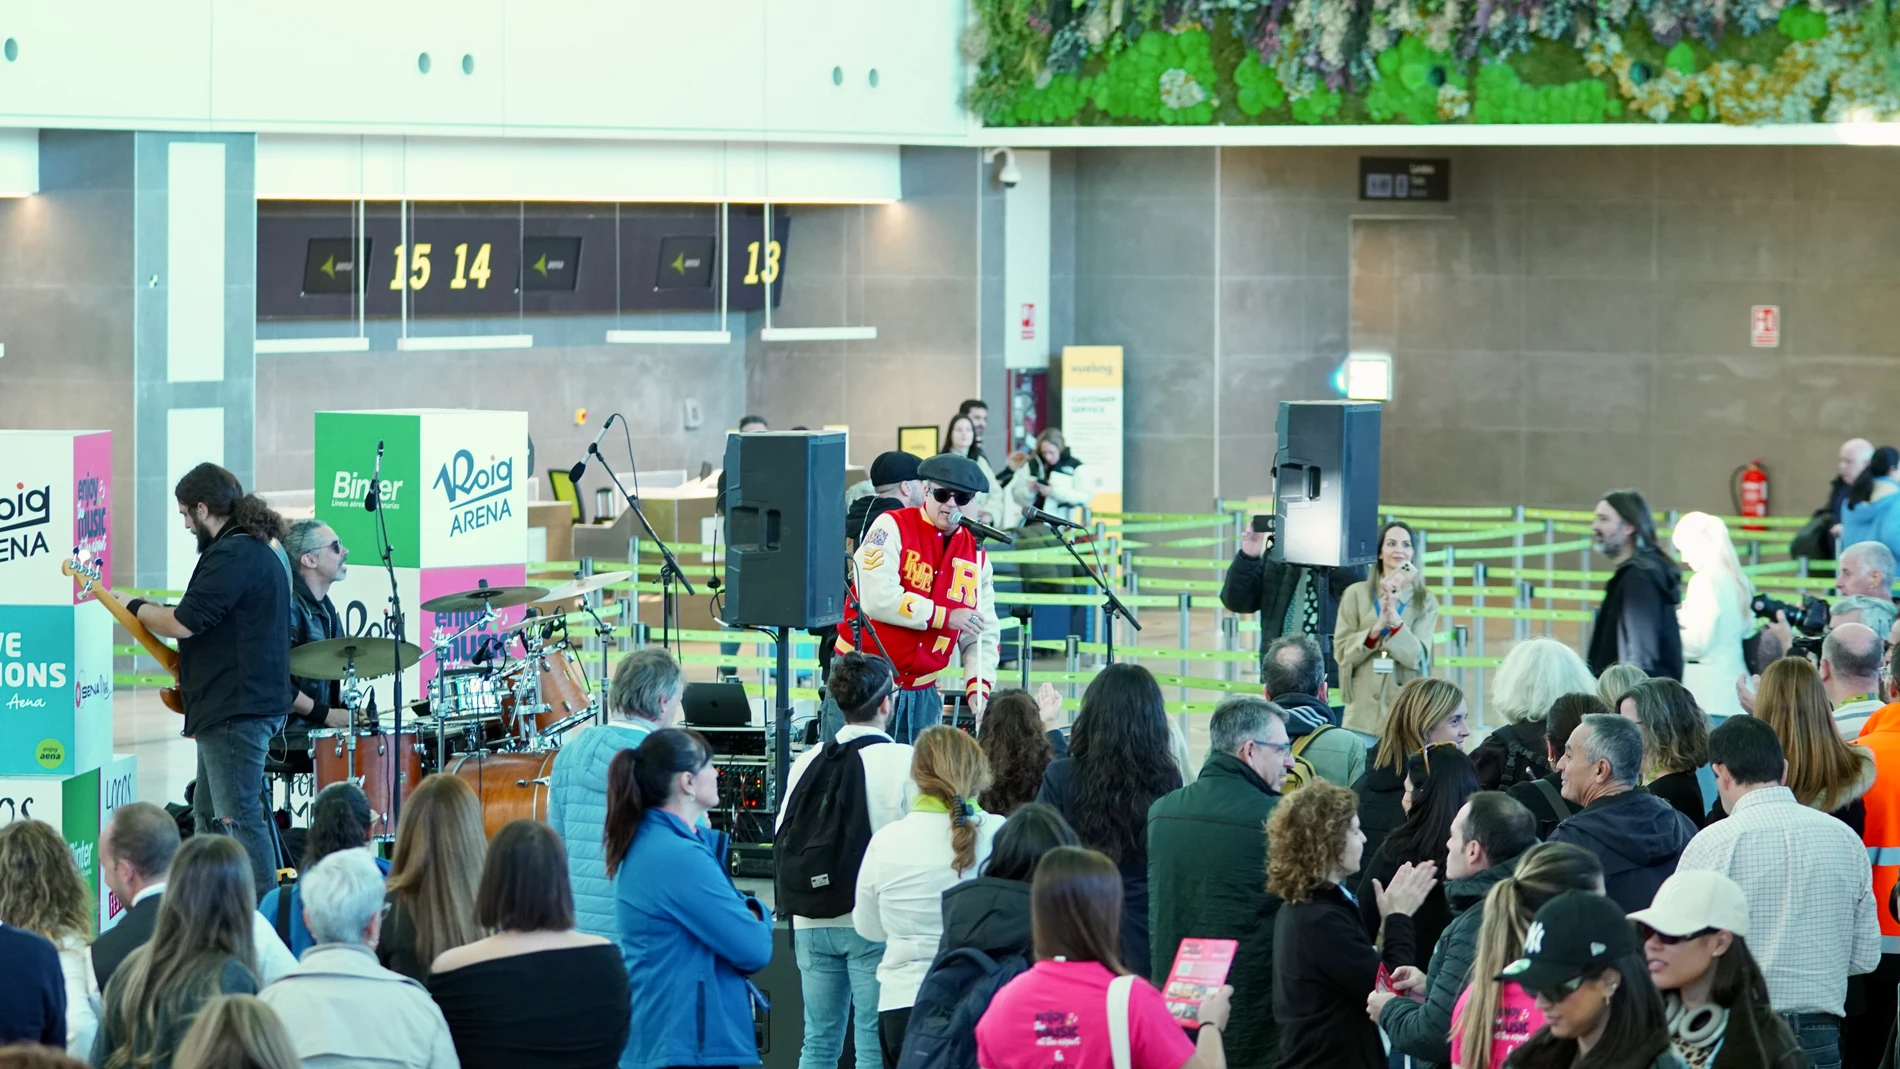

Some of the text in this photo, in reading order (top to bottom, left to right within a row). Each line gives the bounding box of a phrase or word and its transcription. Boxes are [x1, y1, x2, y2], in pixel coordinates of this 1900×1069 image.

[390, 242, 432, 290] 15
[450, 242, 491, 289] 14
[743, 240, 781, 285] 13
[332, 471, 403, 501] Biner
[433, 449, 512, 502] Roig
[450, 498, 512, 538] ARENA
[6, 693, 46, 710] Aena
[43, 746, 58, 755] enjoy
